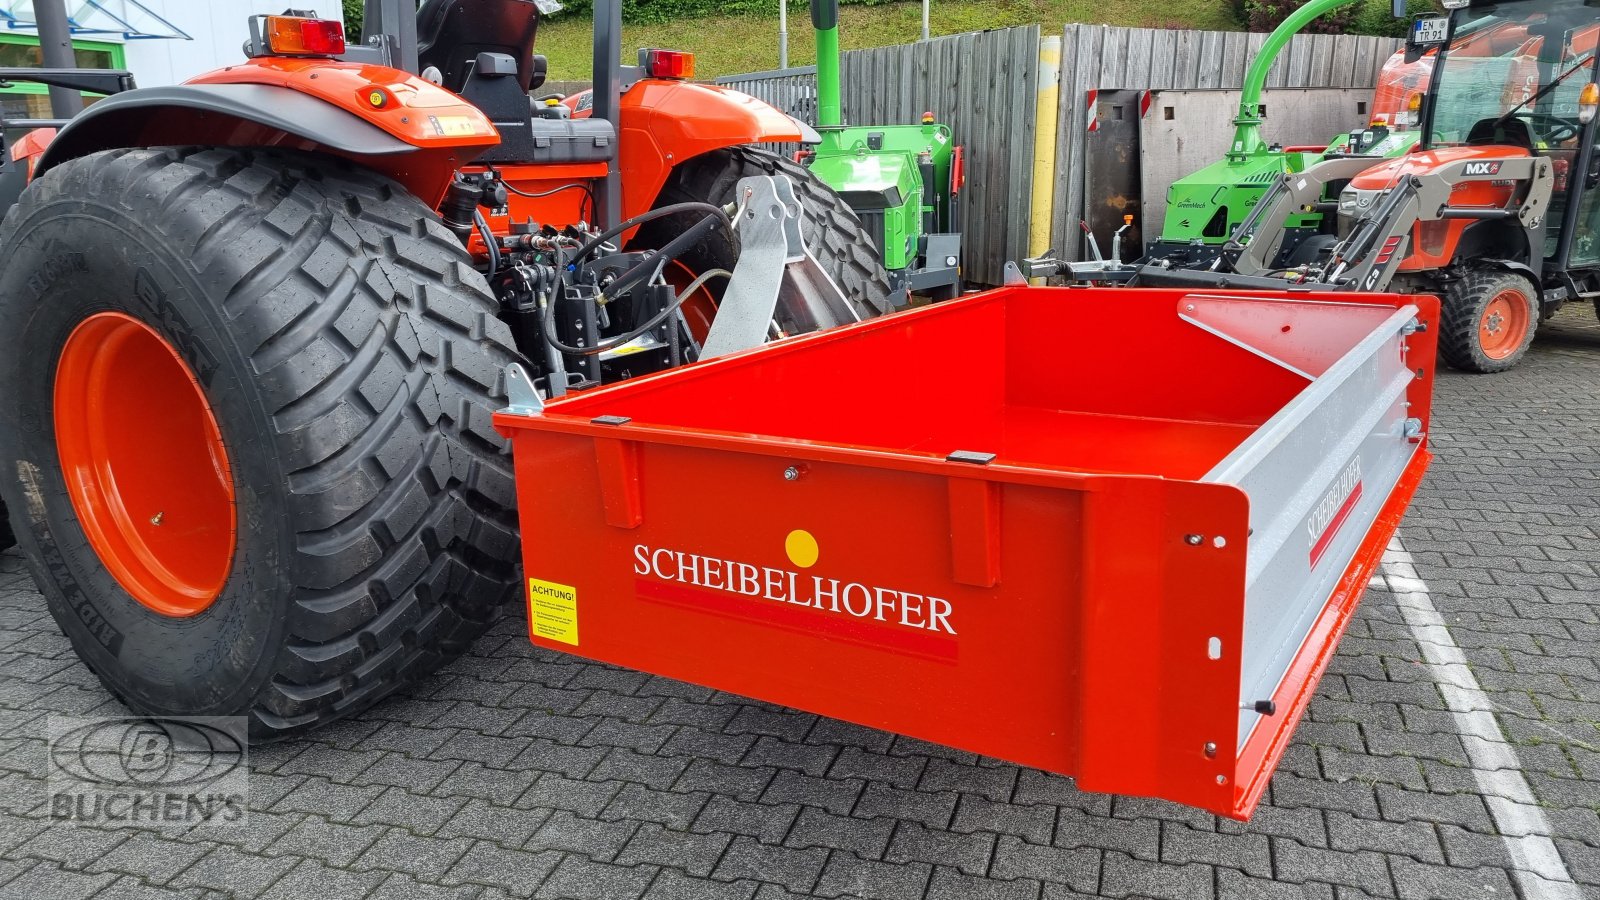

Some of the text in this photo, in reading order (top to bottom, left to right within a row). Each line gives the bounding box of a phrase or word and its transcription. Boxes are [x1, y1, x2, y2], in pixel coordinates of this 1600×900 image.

[1423, 21, 1434, 30] EN
[1420, 30, 1443, 40] TR 91
[1466, 163, 1490, 174] MX
[1177, 201, 1206, 209] GreenMech
[1307, 454, 1361, 546] SCHEIBELHOFER
[532, 585, 574, 601] ACHTUNG!
[634, 544, 958, 635] SCHEIBELHOFER
